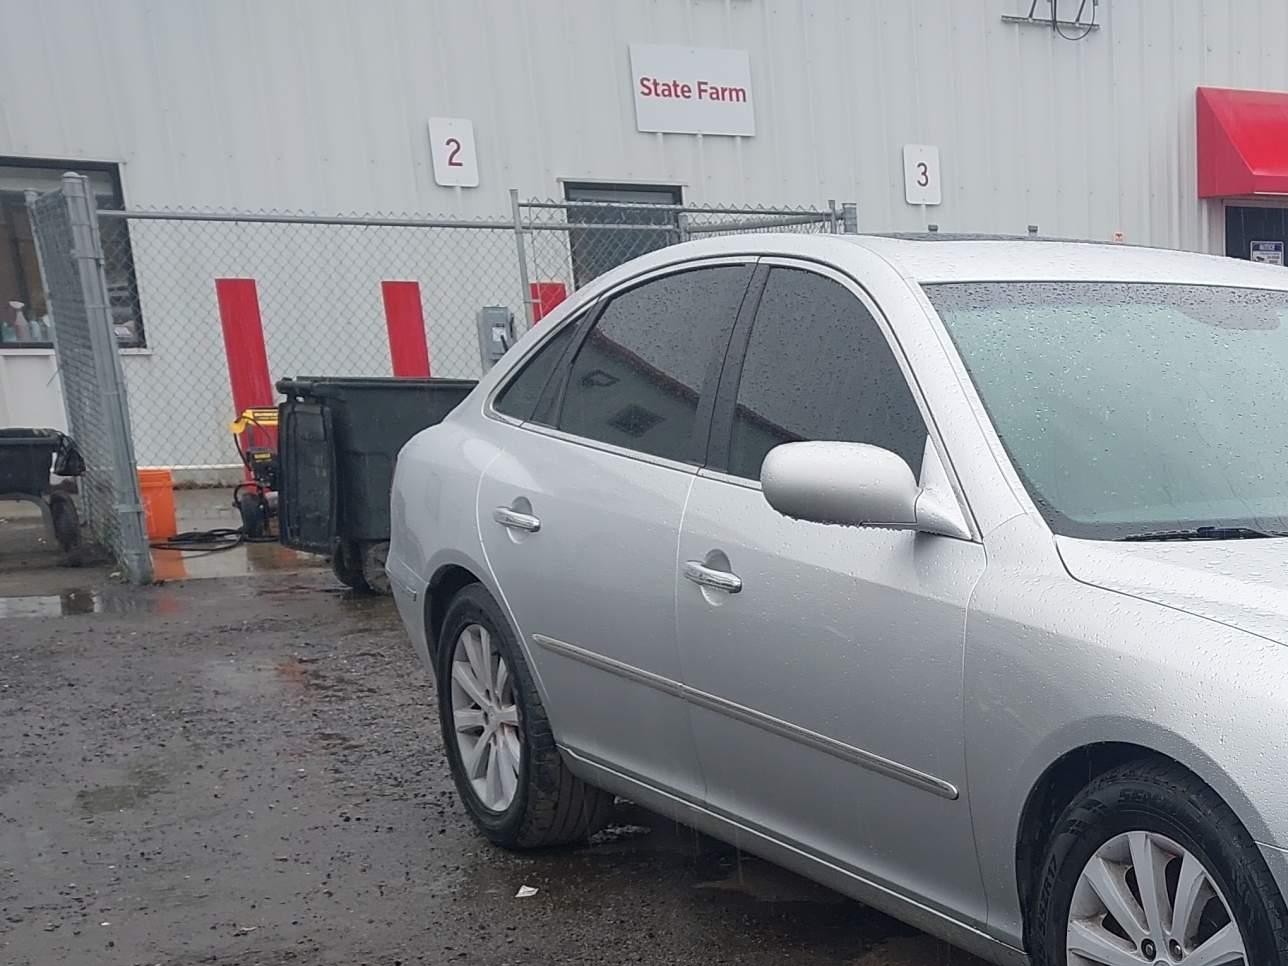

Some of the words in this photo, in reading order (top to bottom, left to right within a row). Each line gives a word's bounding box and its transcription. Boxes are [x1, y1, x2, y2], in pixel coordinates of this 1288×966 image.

[639, 77, 692, 99] State
[697, 80, 747, 103] Farm
[445, 137, 464, 167] 2
[916, 161, 929, 188] 3
